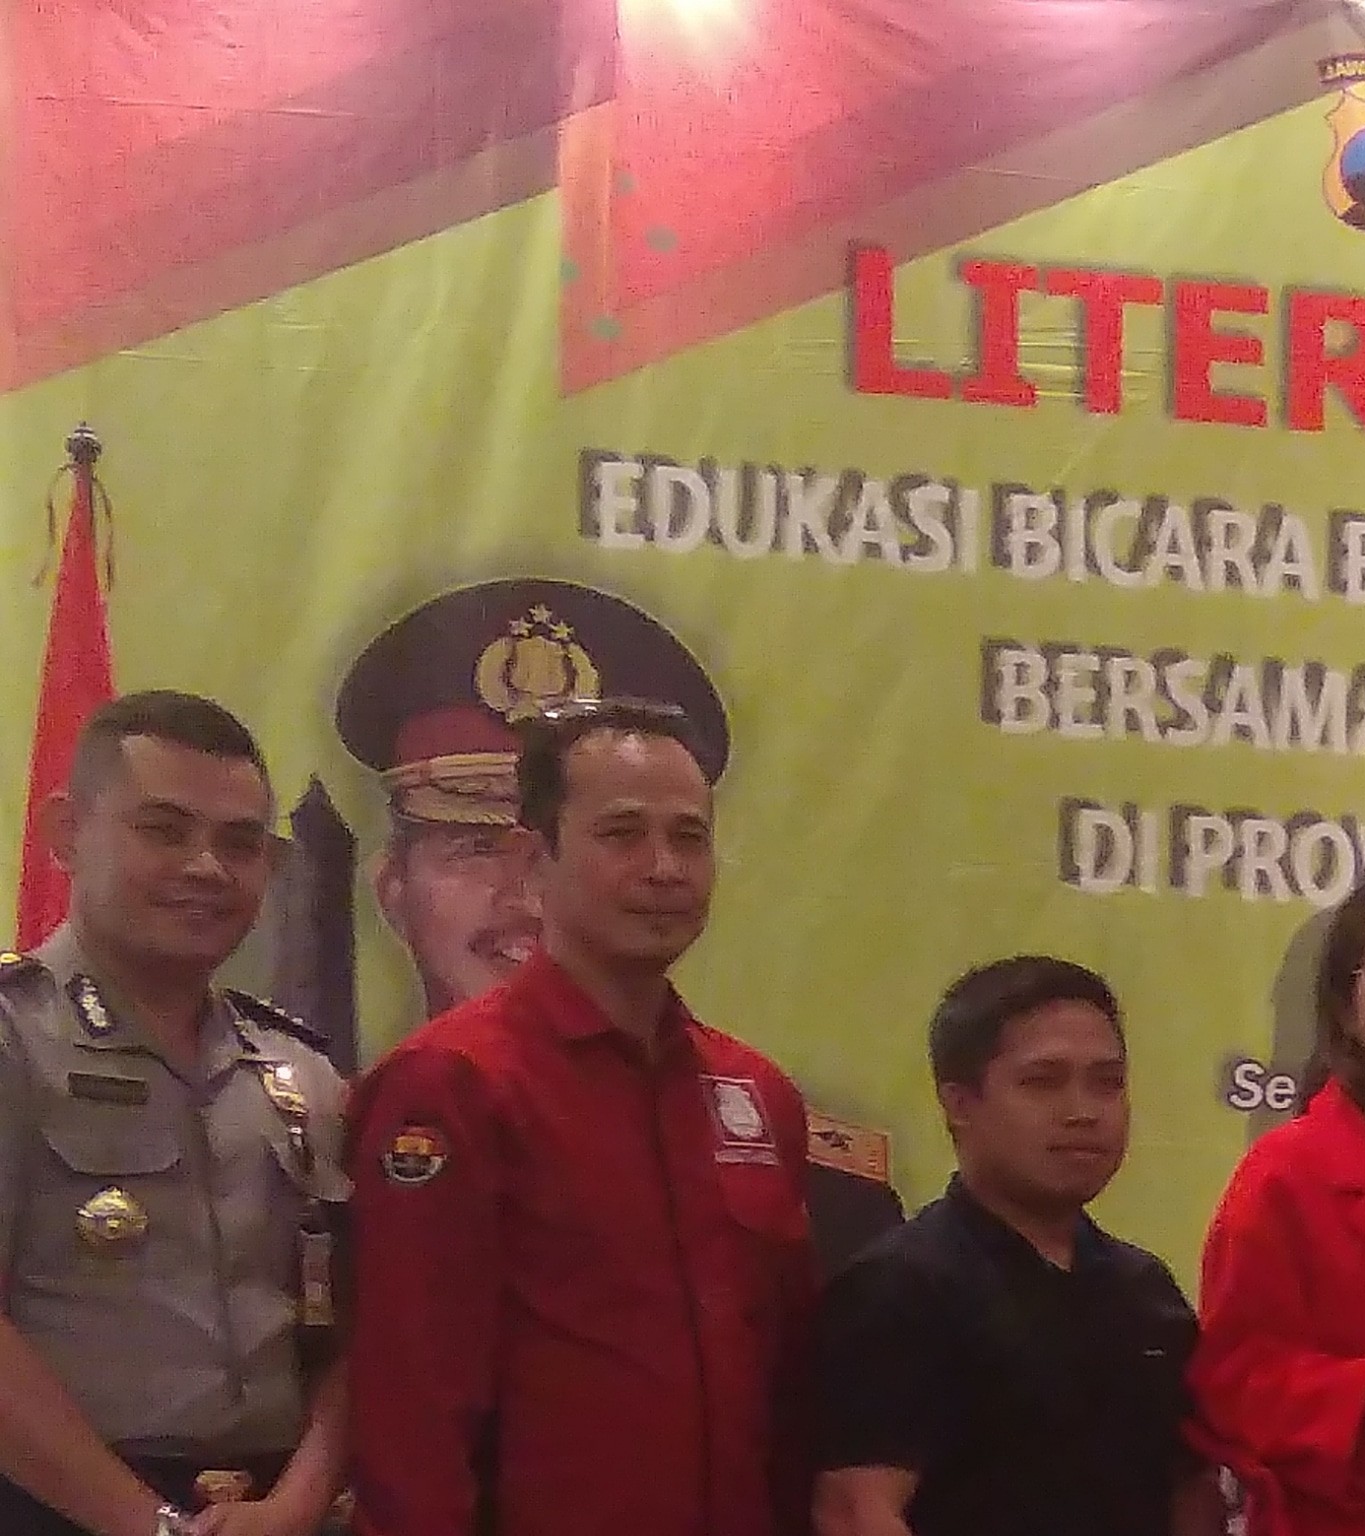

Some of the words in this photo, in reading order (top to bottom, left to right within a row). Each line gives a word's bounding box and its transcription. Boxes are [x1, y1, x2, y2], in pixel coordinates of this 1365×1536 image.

[594, 458, 979, 575] EDUKASI
[1003, 483, 1320, 599] BICARA
[1074, 806, 1159, 896] DI
[1228, 1060, 1297, 1111] Se
